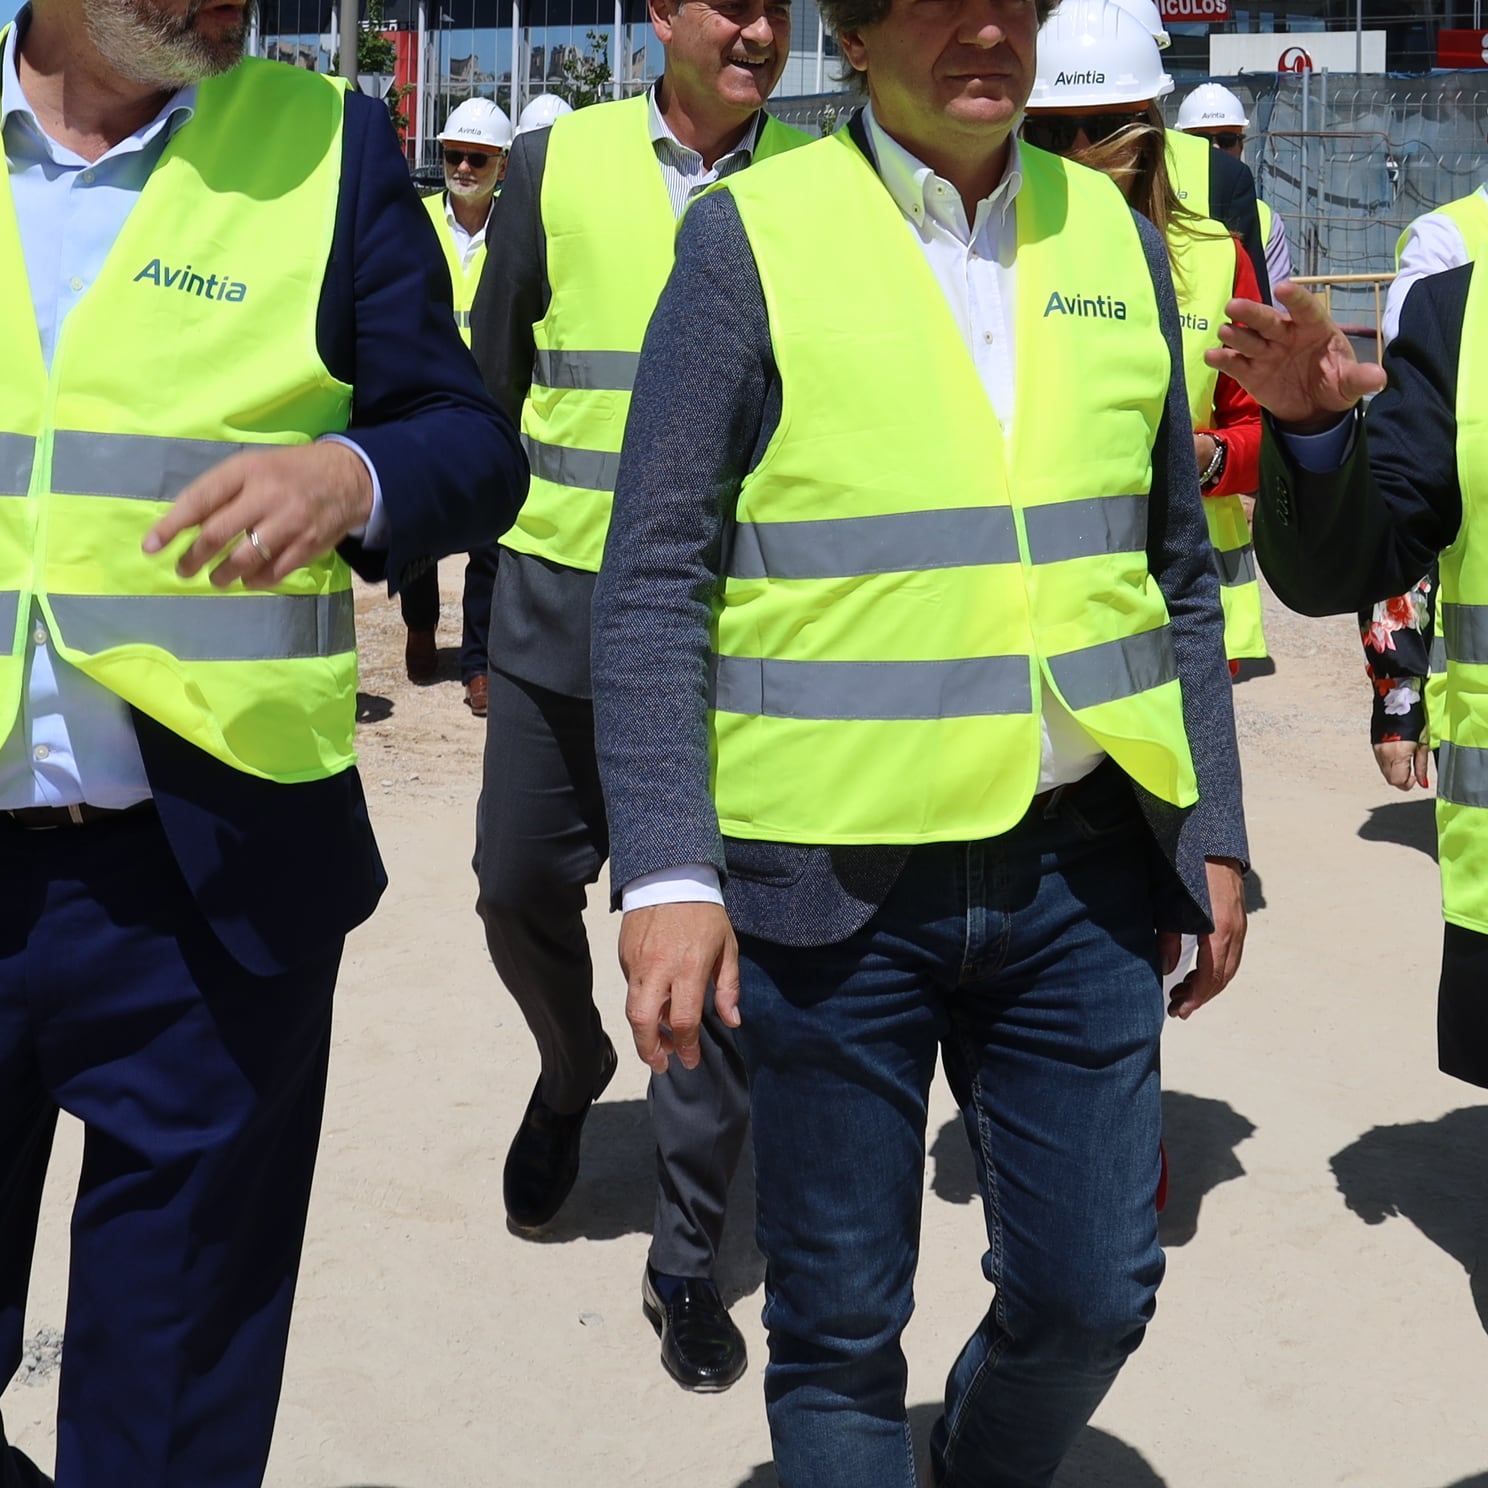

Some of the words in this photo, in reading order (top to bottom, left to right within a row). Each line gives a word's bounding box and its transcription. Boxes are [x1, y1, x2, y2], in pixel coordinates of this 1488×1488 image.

[1054, 70, 1106, 86] Avintia
[1201, 112, 1226, 120] Avintia
[457, 126, 482, 136] Avintia
[132, 258, 248, 302] Avintia
[1043, 291, 1127, 321] Avintia
